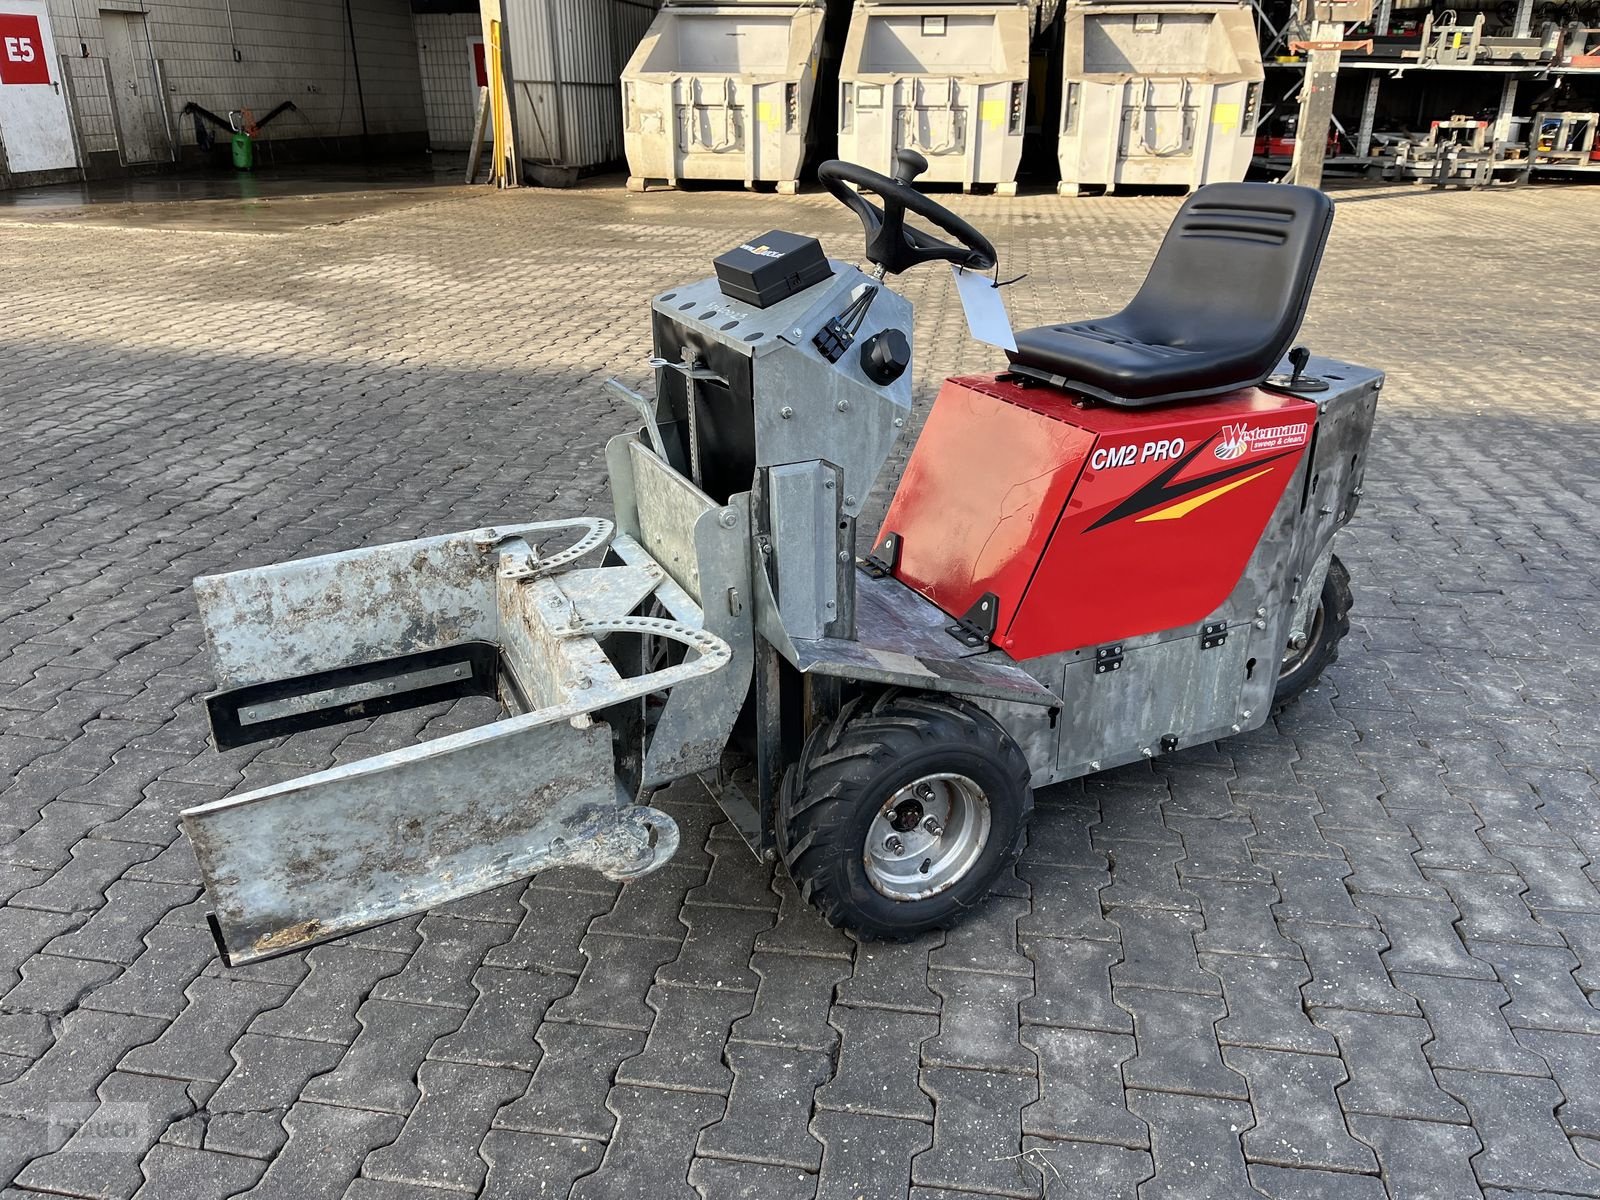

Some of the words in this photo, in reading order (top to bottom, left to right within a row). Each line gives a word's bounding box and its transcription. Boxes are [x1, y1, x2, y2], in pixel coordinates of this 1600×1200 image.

[4, 37, 35, 62] E5
[1222, 423, 1307, 447] Westermann
[1253, 440, 1276, 449] sweep
[1091, 444, 1137, 470] CM2
[1140, 437, 1185, 463] PRO
